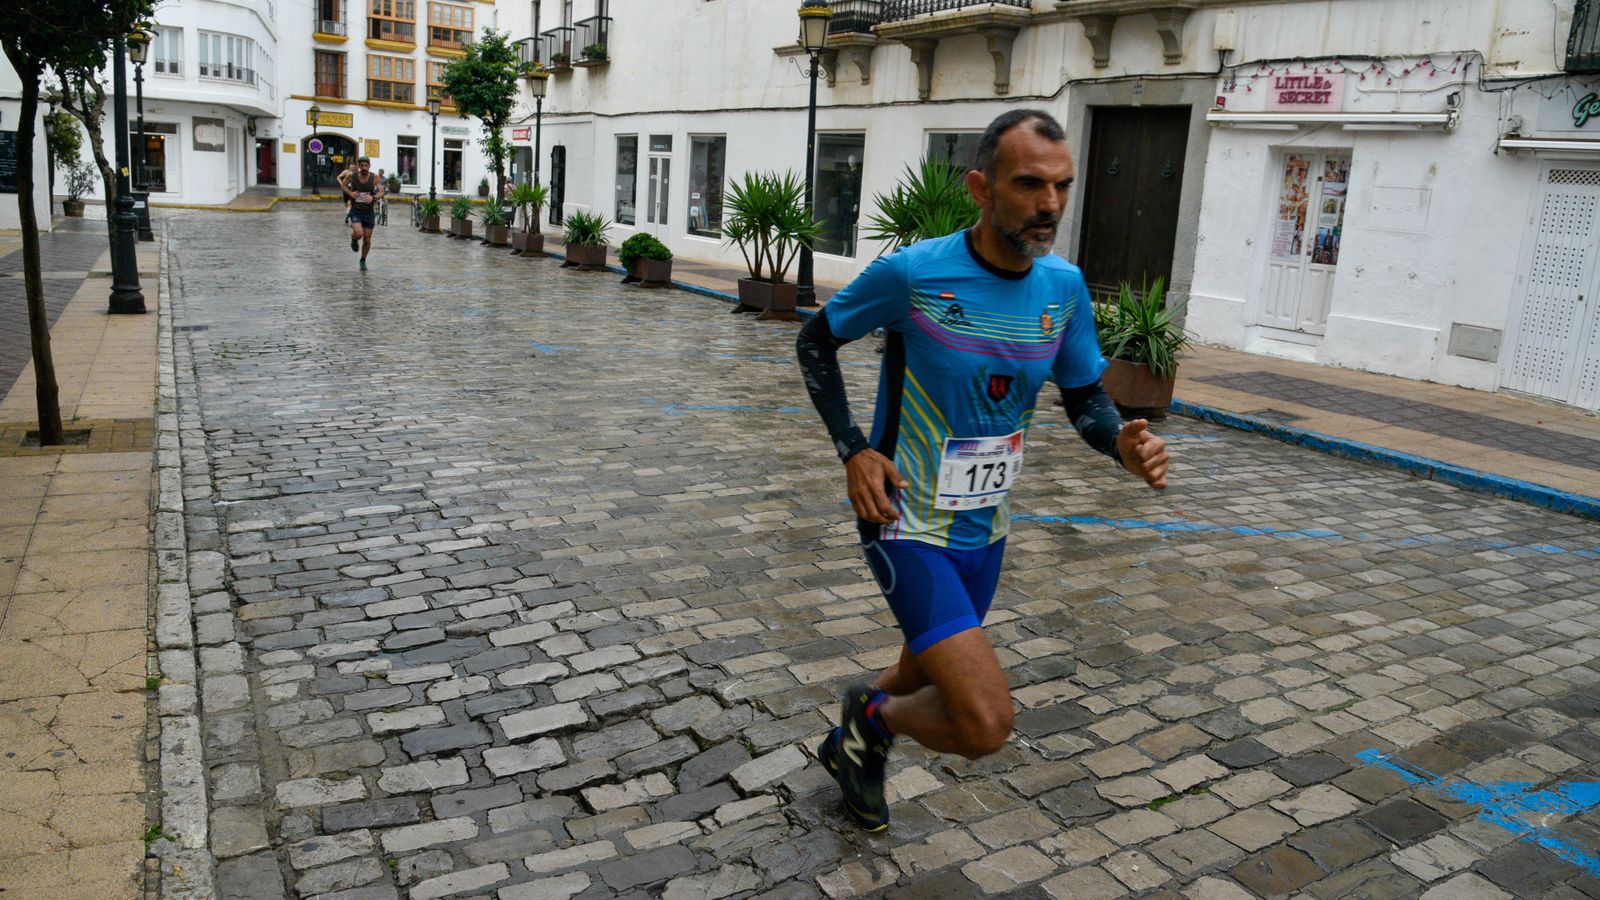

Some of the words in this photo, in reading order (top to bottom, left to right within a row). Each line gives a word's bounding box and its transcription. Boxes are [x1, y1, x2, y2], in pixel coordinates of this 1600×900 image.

[1223, 80, 1234, 90] 22
[1275, 76, 1324, 90] LITTLE
[1278, 91, 1332, 104] SECRET
[966, 462, 1007, 491] 173
